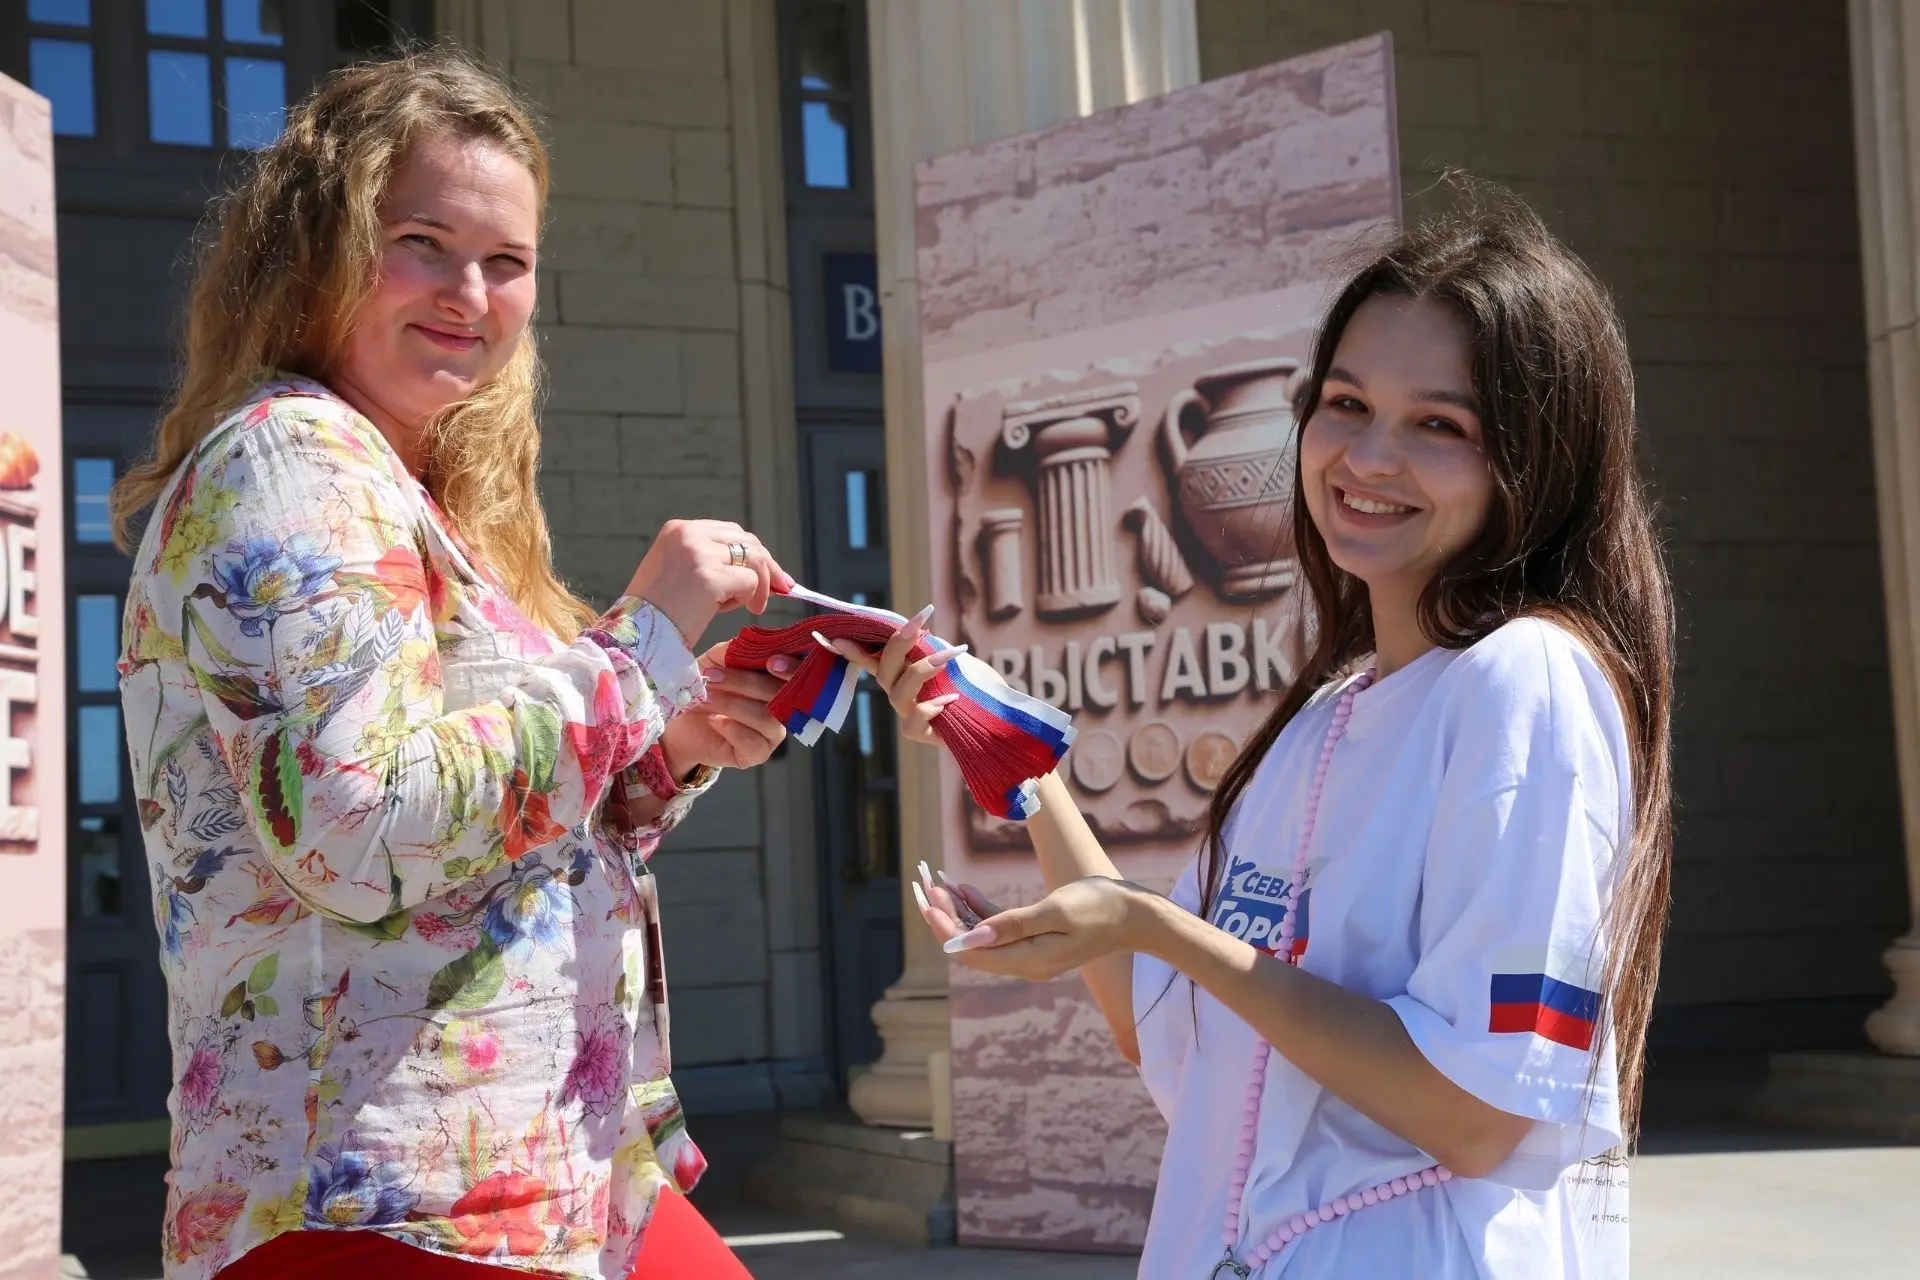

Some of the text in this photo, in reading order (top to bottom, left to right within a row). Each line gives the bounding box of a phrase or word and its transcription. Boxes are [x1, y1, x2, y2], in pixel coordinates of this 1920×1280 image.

[843, 283, 877, 340] В
[991, 615, 1293, 708] ВЫСТАВК
[1241, 871, 1294, 899] СЕВА
[1213, 900, 1286, 951] ГОРО
